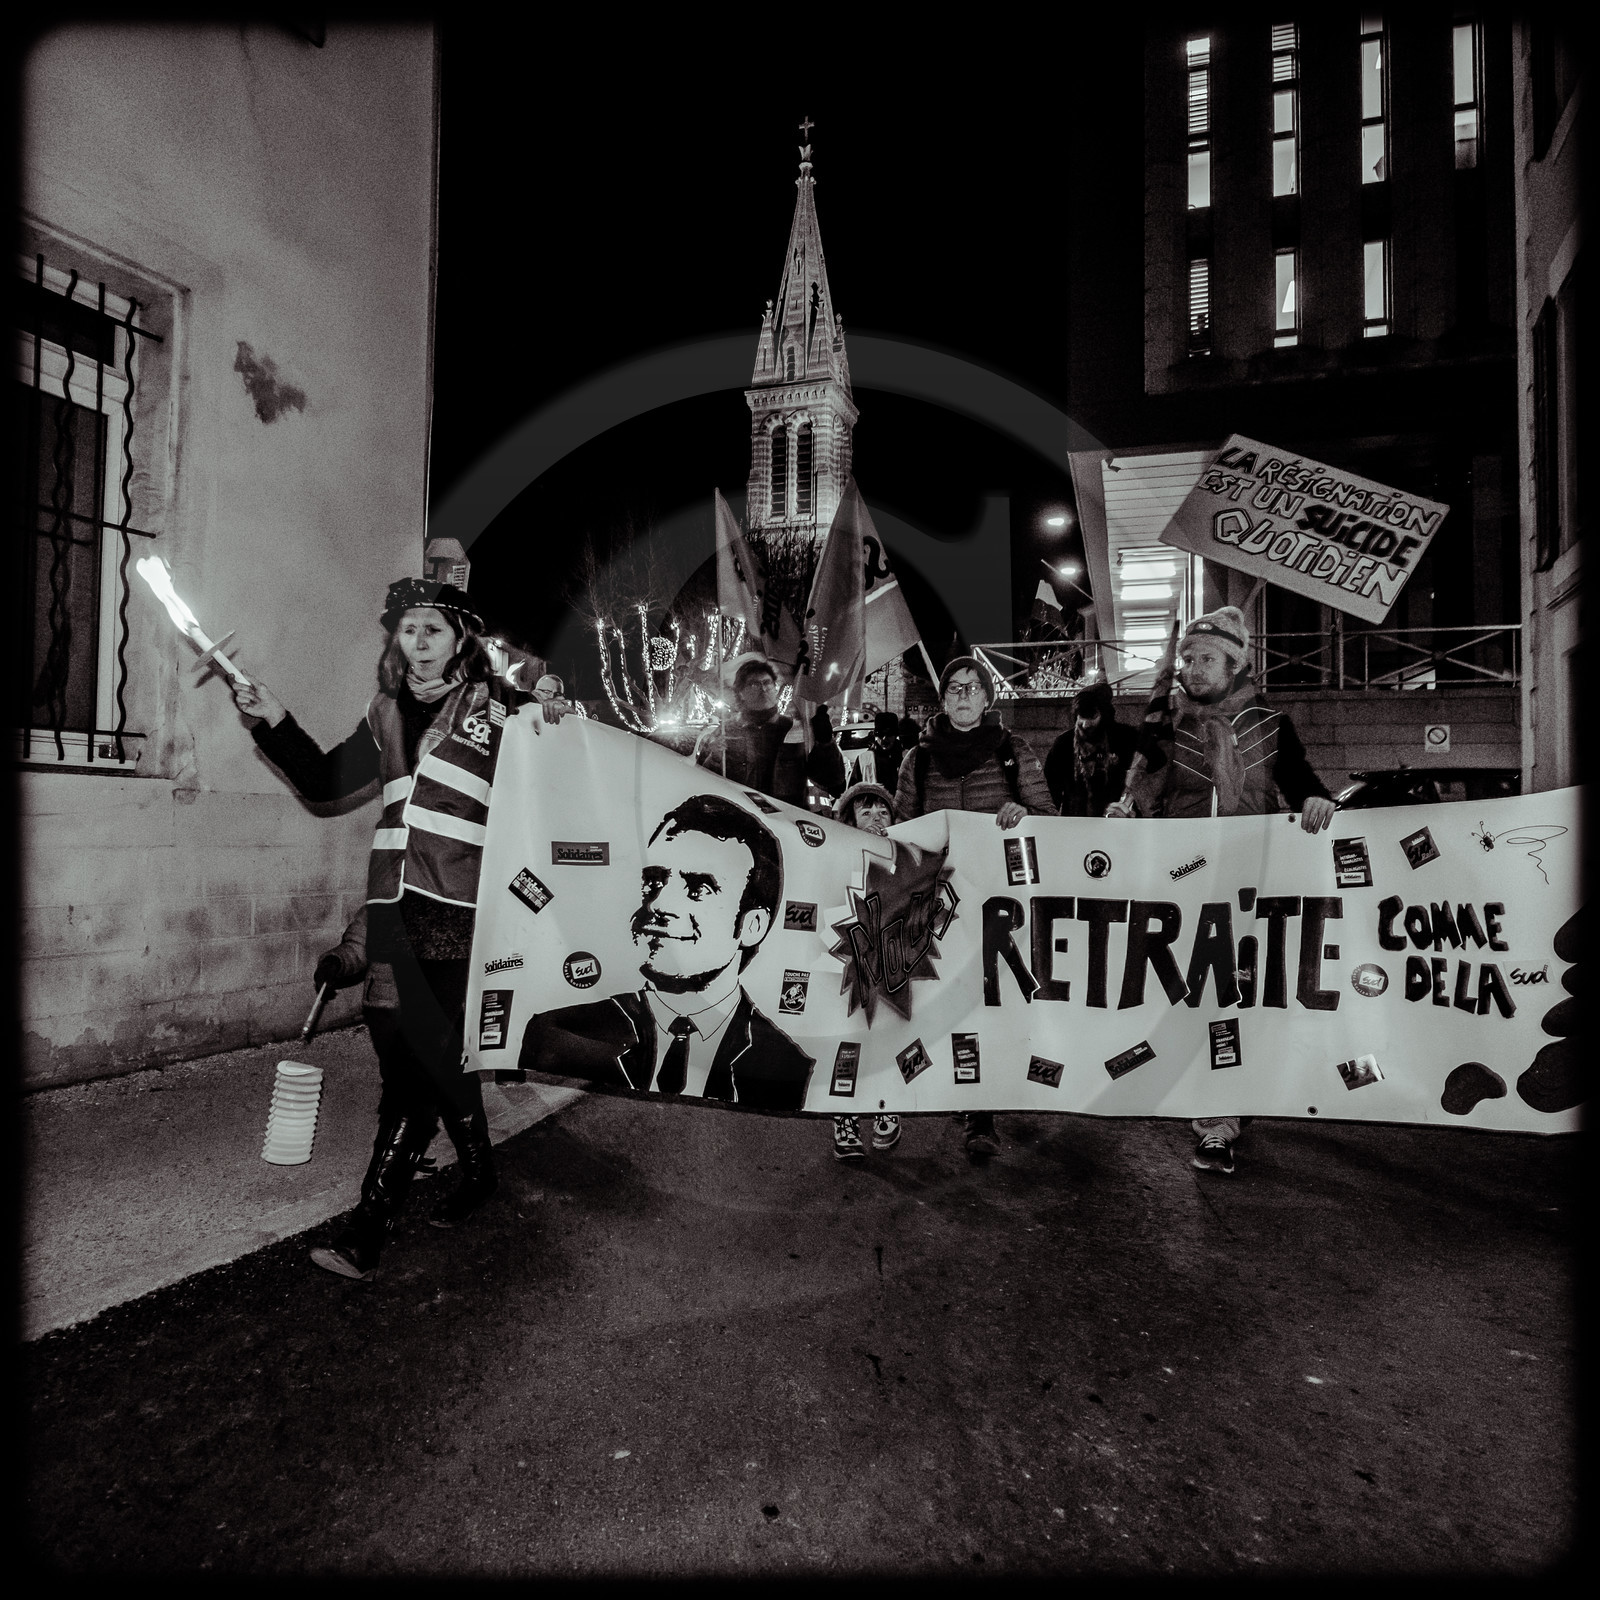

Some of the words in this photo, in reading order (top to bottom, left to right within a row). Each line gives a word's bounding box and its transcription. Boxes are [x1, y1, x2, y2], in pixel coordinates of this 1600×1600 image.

[1217, 447, 1259, 474] LA
[1198, 469, 1256, 501] EST
[1252, 484, 1305, 519] UN
[463, 716, 491, 744] cgt
[557, 847, 603, 861] Solidaires
[1169, 854, 1208, 877] Solidaires
[1377, 894, 1510, 952] COMME
[484, 957, 524, 974] Solidaires
